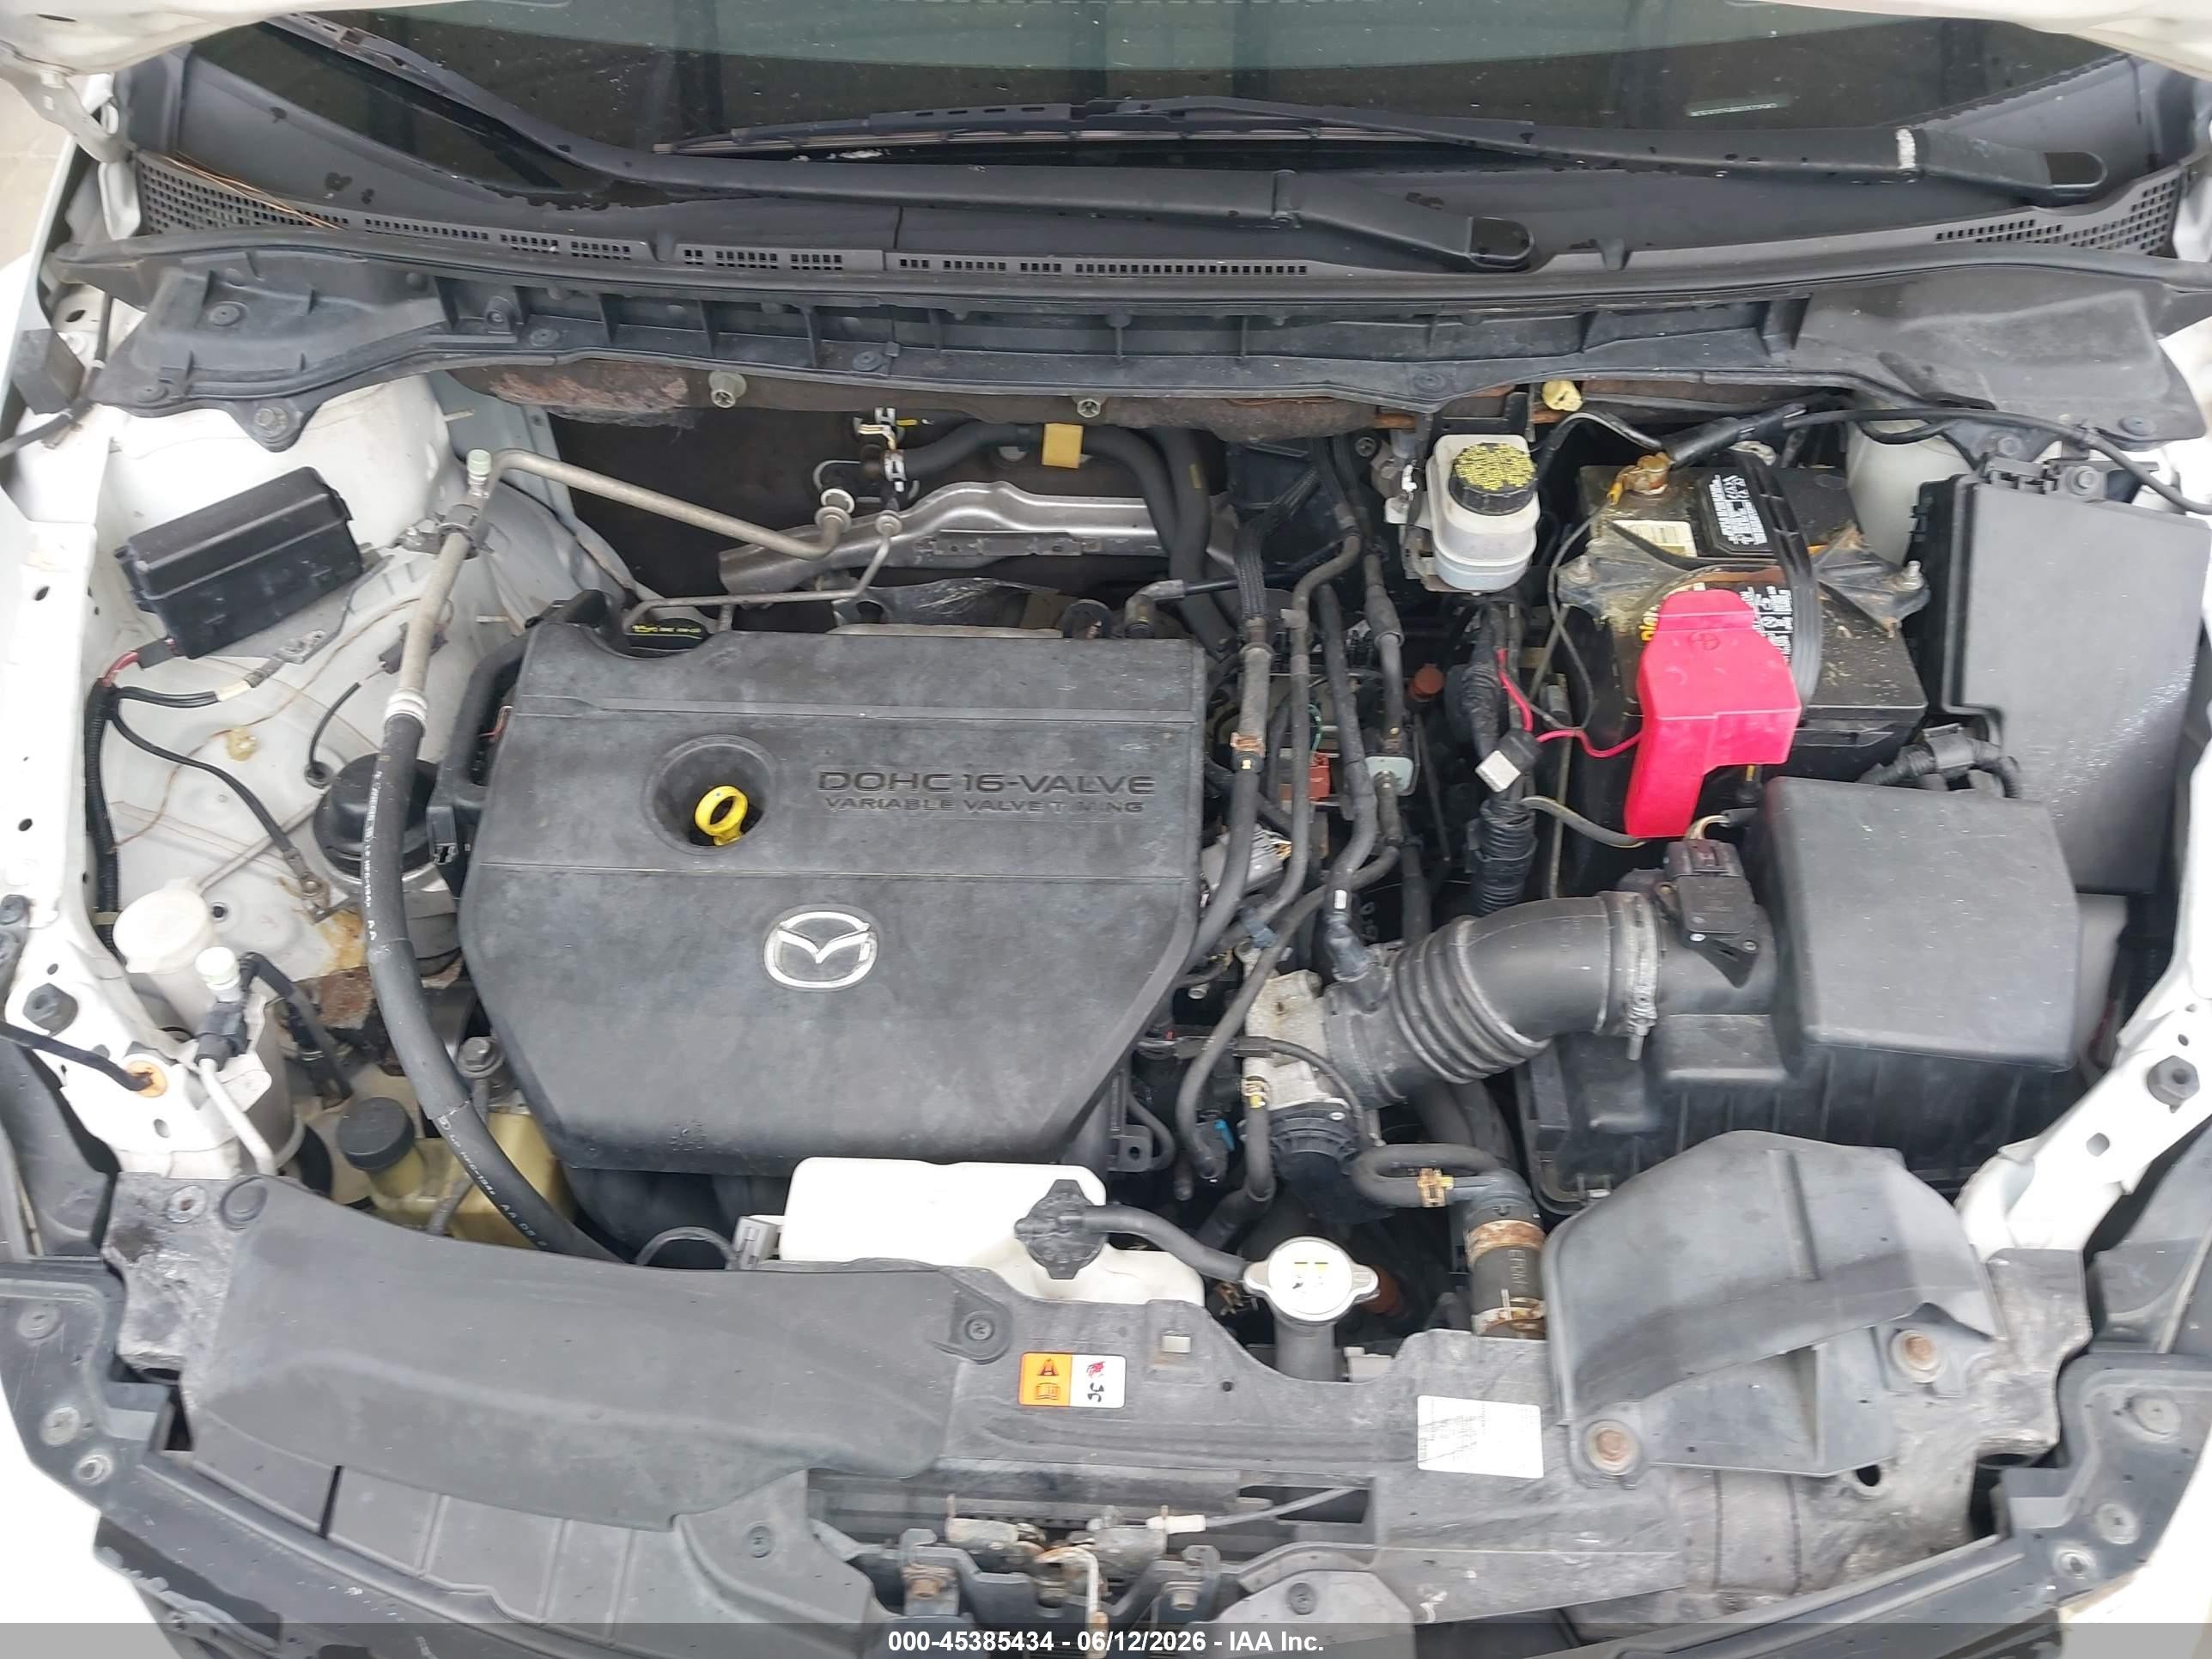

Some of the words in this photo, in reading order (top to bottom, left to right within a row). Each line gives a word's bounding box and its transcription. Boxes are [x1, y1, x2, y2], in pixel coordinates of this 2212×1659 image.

[818, 771, 954, 792] DOHC
[962, 773, 1156, 795] 16-VALVE
[824, 797, 955, 812] VARIABLE
[963, 799, 1044, 814] VALVE
[1049, 799, 1145, 814] TMNG
